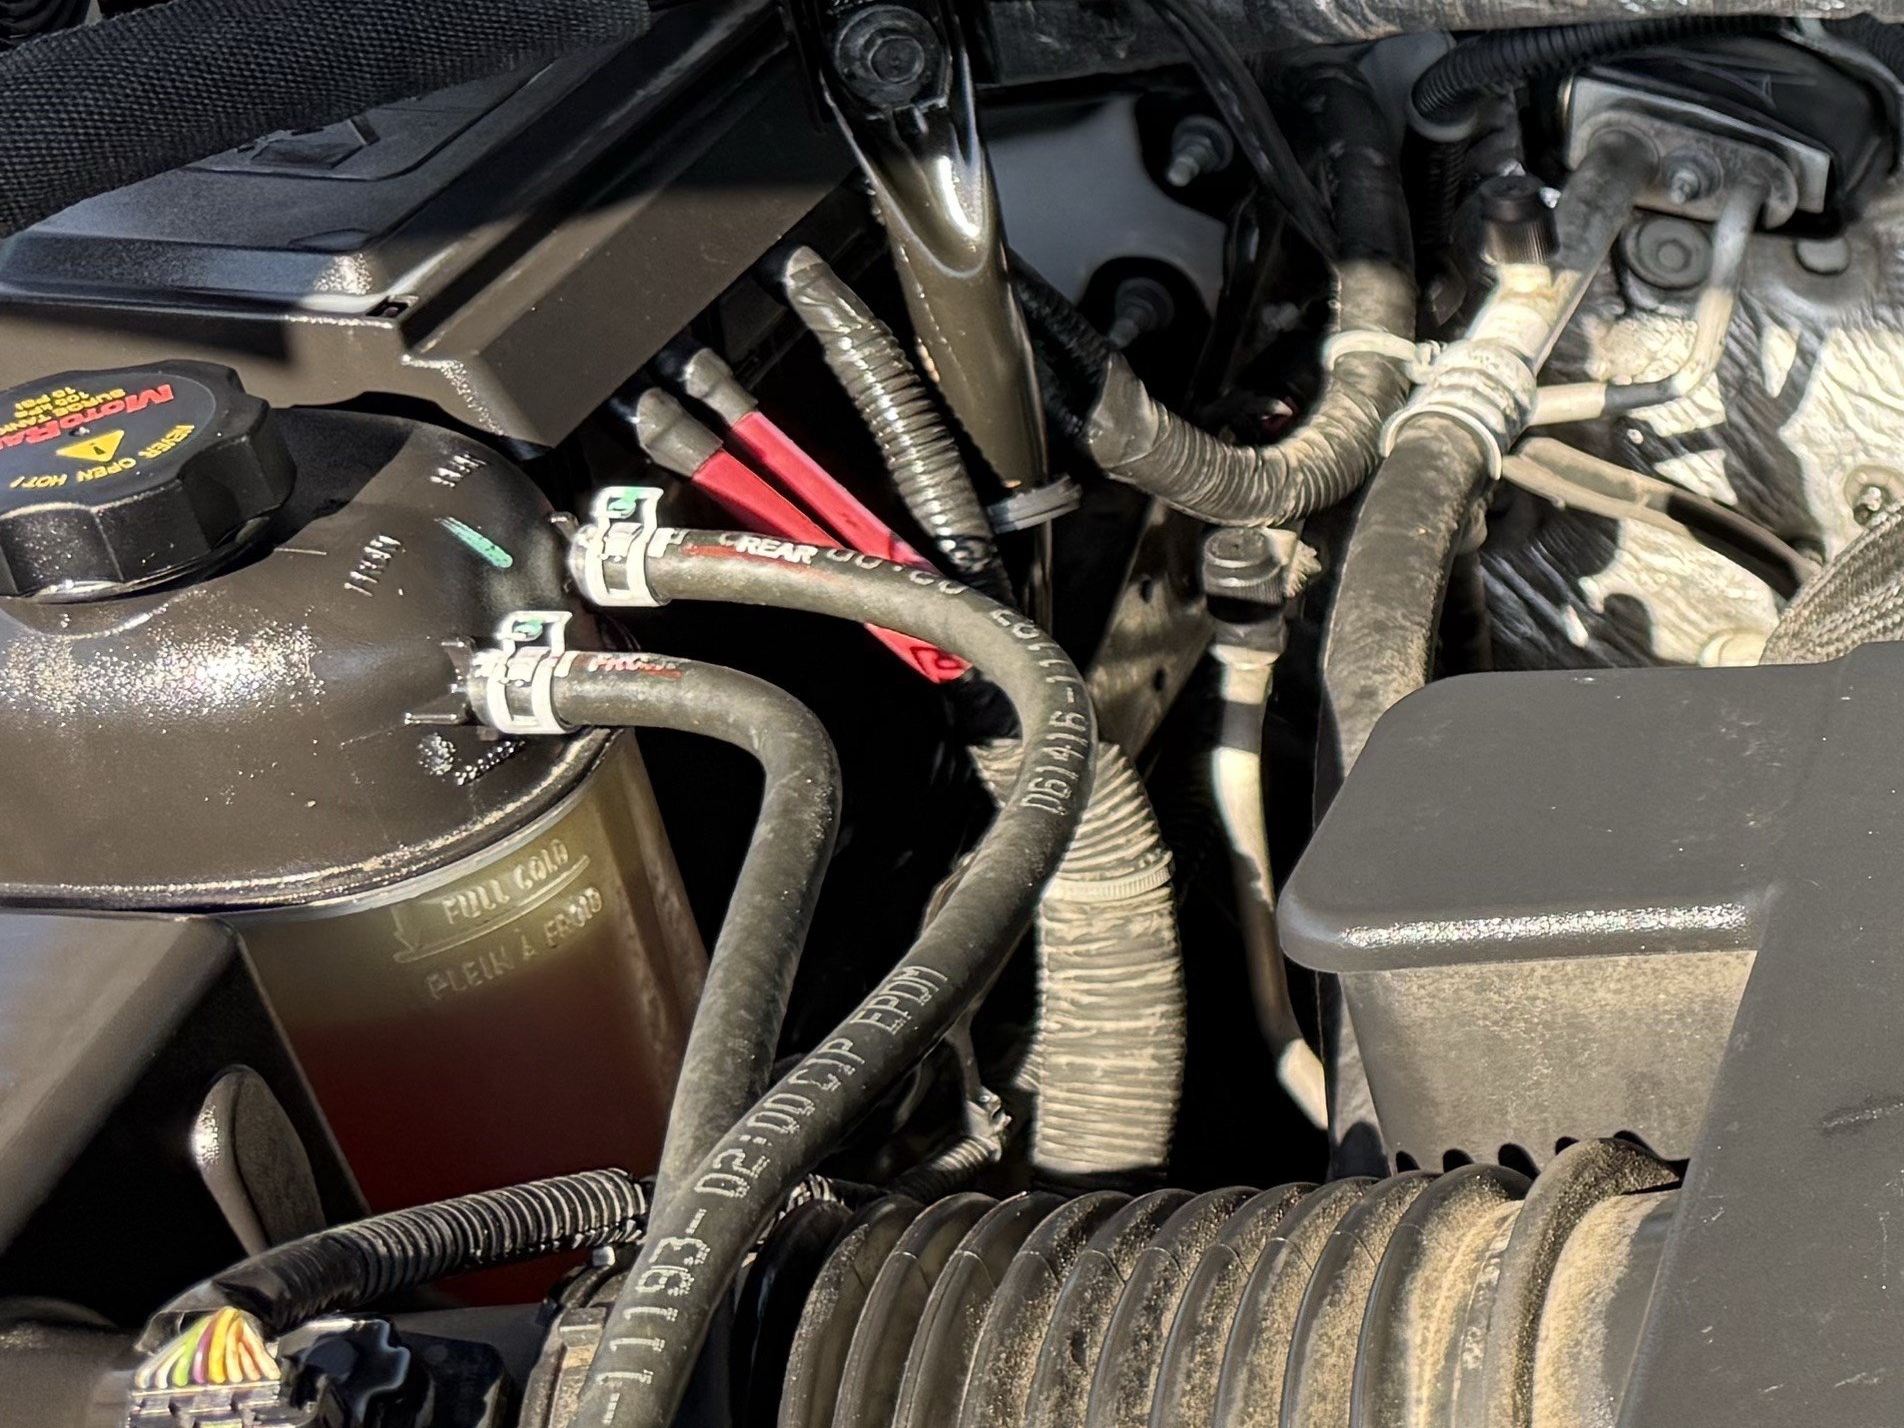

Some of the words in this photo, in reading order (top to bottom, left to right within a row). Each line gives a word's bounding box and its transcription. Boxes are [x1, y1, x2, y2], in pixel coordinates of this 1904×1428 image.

[0, 384, 175, 450] MOTORA
[52, 388, 126, 417] SURGE
[76, 456, 136, 483] OPEN
[734, 535, 818, 565] REAR
[441, 879, 511, 925] FULL
[425, 945, 515, 1001] PLEIN
[544, 886, 603, 949] FROID
[851, 966, 949, 1034] EPDM
